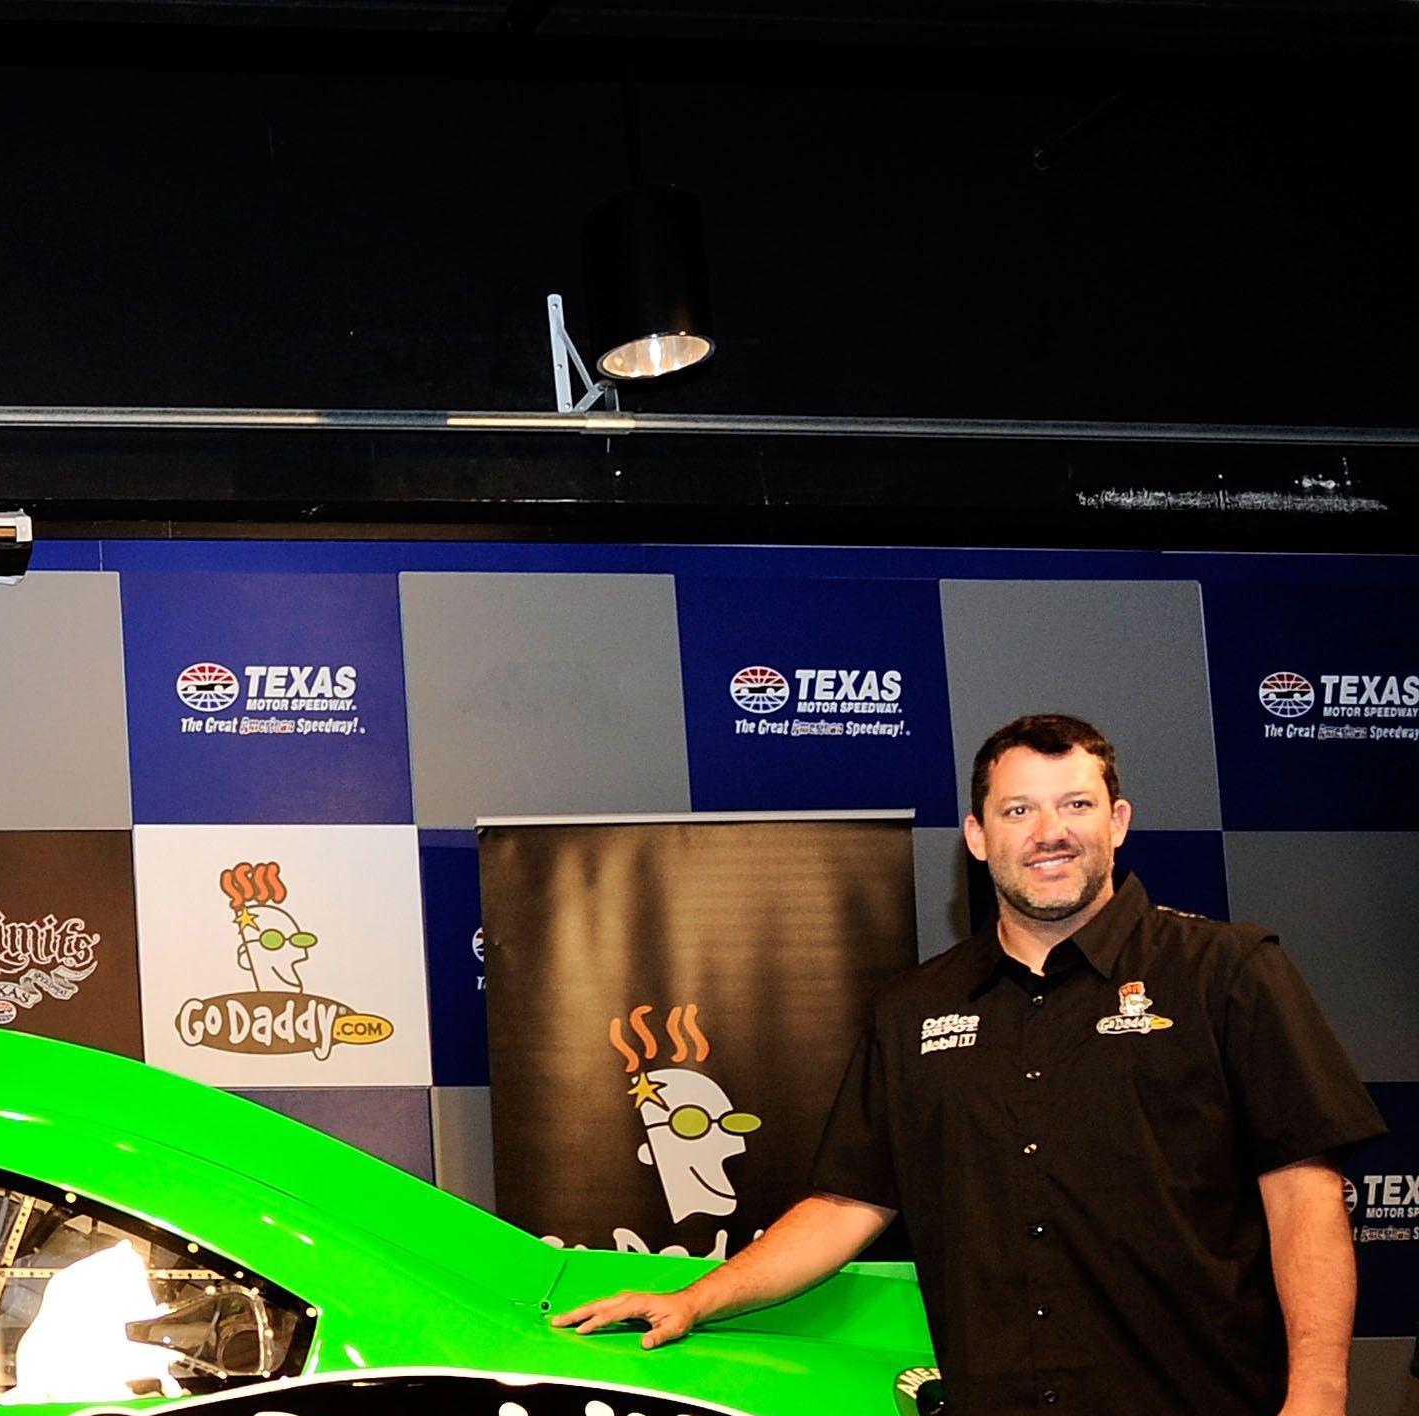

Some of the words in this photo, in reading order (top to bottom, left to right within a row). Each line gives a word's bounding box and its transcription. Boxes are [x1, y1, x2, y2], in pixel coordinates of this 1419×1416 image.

[245, 666, 357, 698] TEXAS
[795, 670, 902, 701] TEXAS
[1321, 675, 1419, 706] TEXAS
[246, 699, 289, 711] MOTOR
[797, 702, 837, 713] MOTOR
[1323, 707, 1361, 718] MOTOR
[181, 718, 204, 733] The
[207, 718, 237, 733] Great
[735, 720, 756, 734] The
[758, 720, 789, 734] Great
[1264, 724, 1285, 738] The
[1287, 725, 1315, 739] Great
[180, 999, 222, 1044] Go
[226, 999, 337, 1059] Daddy
[336, 1022, 382, 1036] .COM
[1366, 1207, 1404, 1219] MOTOR
